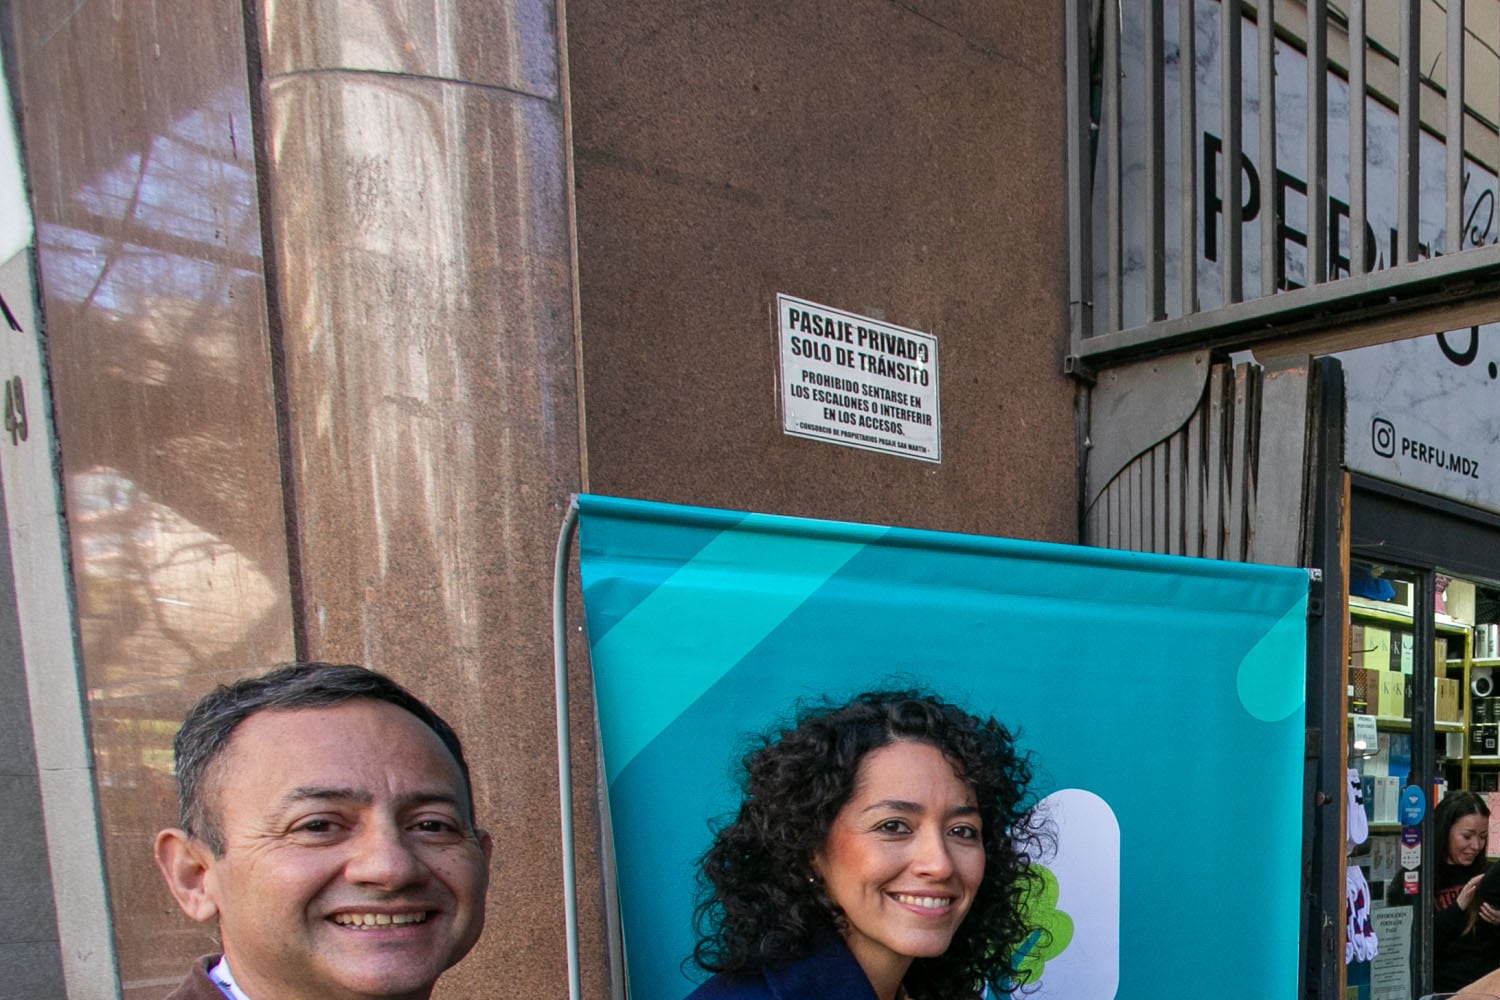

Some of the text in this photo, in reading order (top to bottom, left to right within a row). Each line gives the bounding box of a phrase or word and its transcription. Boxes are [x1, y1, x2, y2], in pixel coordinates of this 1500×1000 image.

[789, 308, 929, 363] PASAJE PRIVADO
[791, 336, 929, 386] SOLO DE TRÁNSITO
[791, 384, 932, 426] LOS ESCALONES O INTERFERIR
[802, 369, 922, 408] PROHIBIDO SENTARSE EN
[823, 407, 905, 436] EN LOS ACCESOS.
[1401, 436, 1480, 479] PERFU.MDZ
